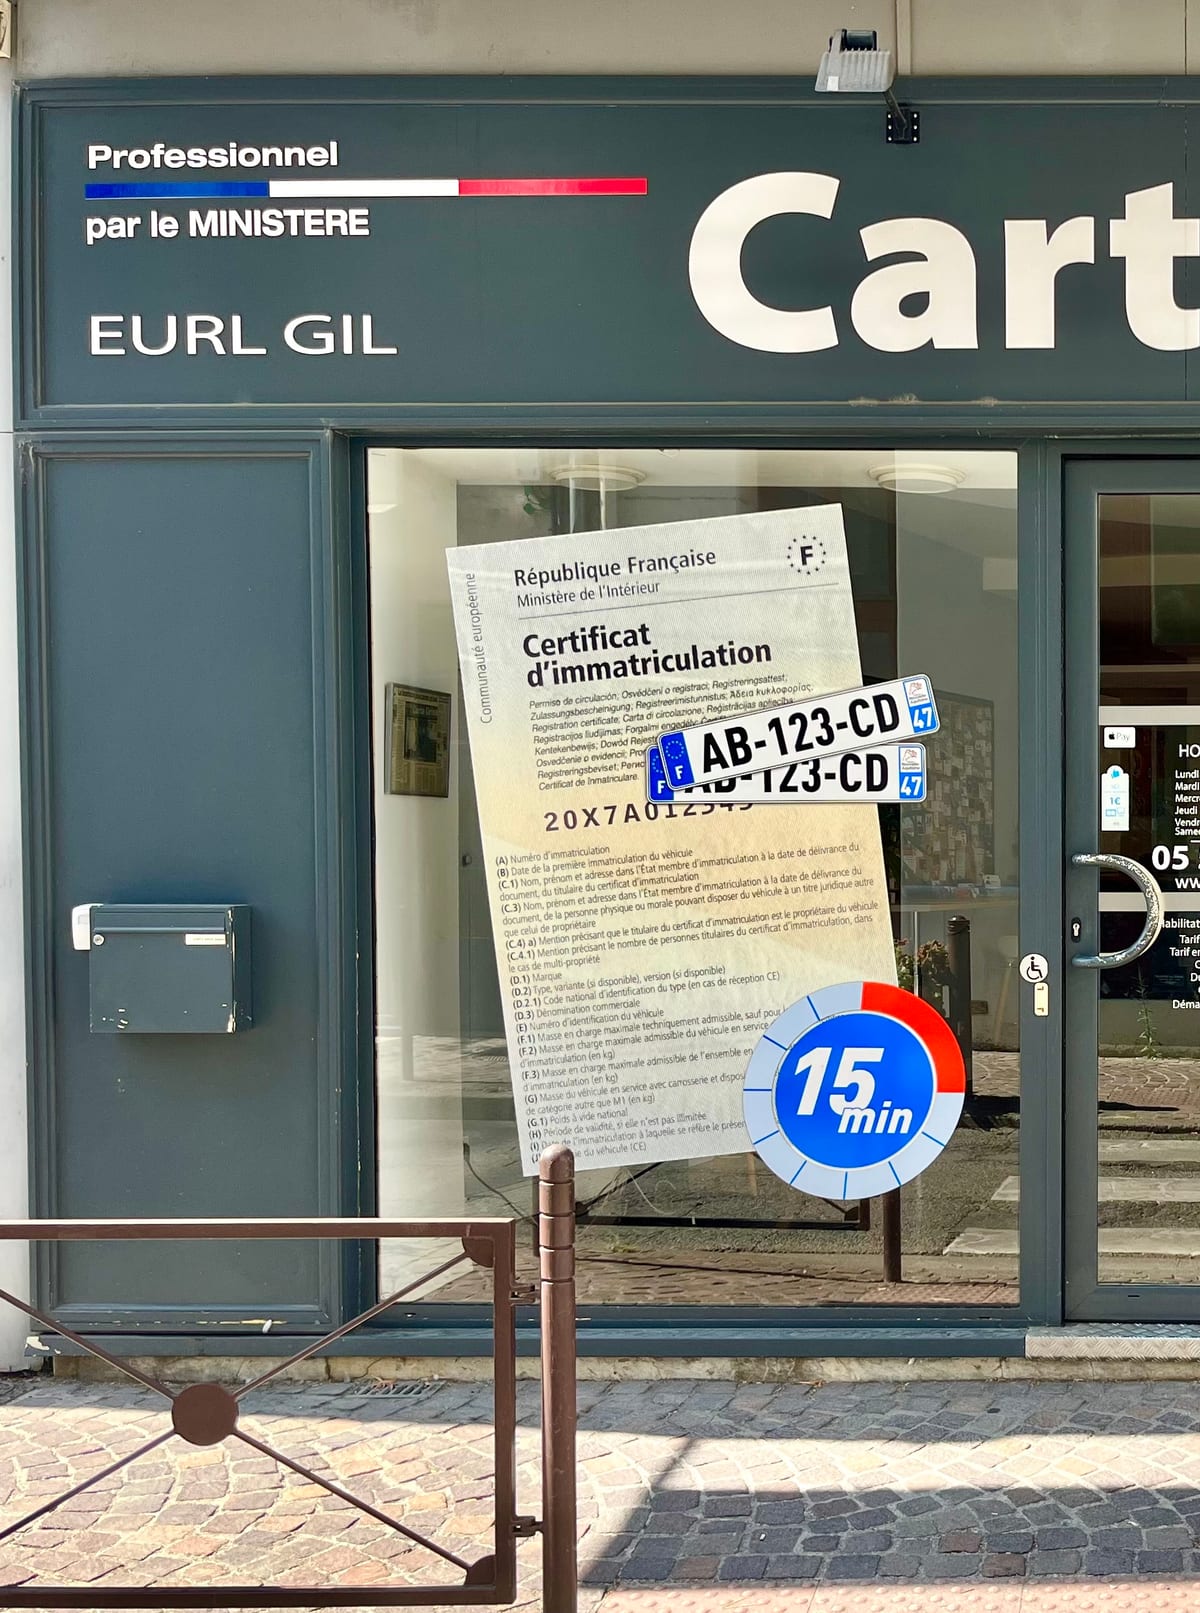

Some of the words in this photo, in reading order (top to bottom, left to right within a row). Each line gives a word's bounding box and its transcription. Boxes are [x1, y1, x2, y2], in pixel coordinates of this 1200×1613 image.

[88, 141, 338, 169] Professionnel
[86, 216, 141, 245] par
[150, 210, 179, 238] le
[189, 209, 370, 237] MINISTERE
[90, 314, 267, 356] EURL
[283, 314, 398, 356] GIL
[800, 545, 814, 566] F
[515, 560, 621, 590] République
[628, 550, 717, 575] Française
[517, 588, 577, 608] Ministère
[580, 586, 595, 601] de
[600, 580, 660, 599] l'Intérieur
[466, 573, 484, 642] européenne
[523, 623, 651, 658] Certificat
[527, 640, 772, 687] d'immatriculation
[475, 644, 493, 724] Communauté
[529, 699, 561, 709] Permiso
[532, 719, 578, 733] Registration
[623, 713, 645, 723] Carta
[912, 707, 932, 730] 47
[702, 693, 900, 774] AB-123-CD
[674, 765, 684, 780] F
[1174, 769, 1200, 779] Lundi
[657, 780, 667, 795] F
[900, 776, 921, 796] 47
[1174, 781, 1200, 791] Mardi
[1174, 805, 1198, 815] Jeudi
[511, 866, 530, 876] Date
[532, 864, 541, 874] de
[588, 854, 647, 868] immatriculation
[650, 851, 660, 861] du
[1151, 845, 1189, 871] 05
[1170, 947, 1191, 957] Tarif
[1179, 935, 1200, 945] Tarif
[794, 1047, 885, 1115] 15
[838, 1100, 913, 1134] min
